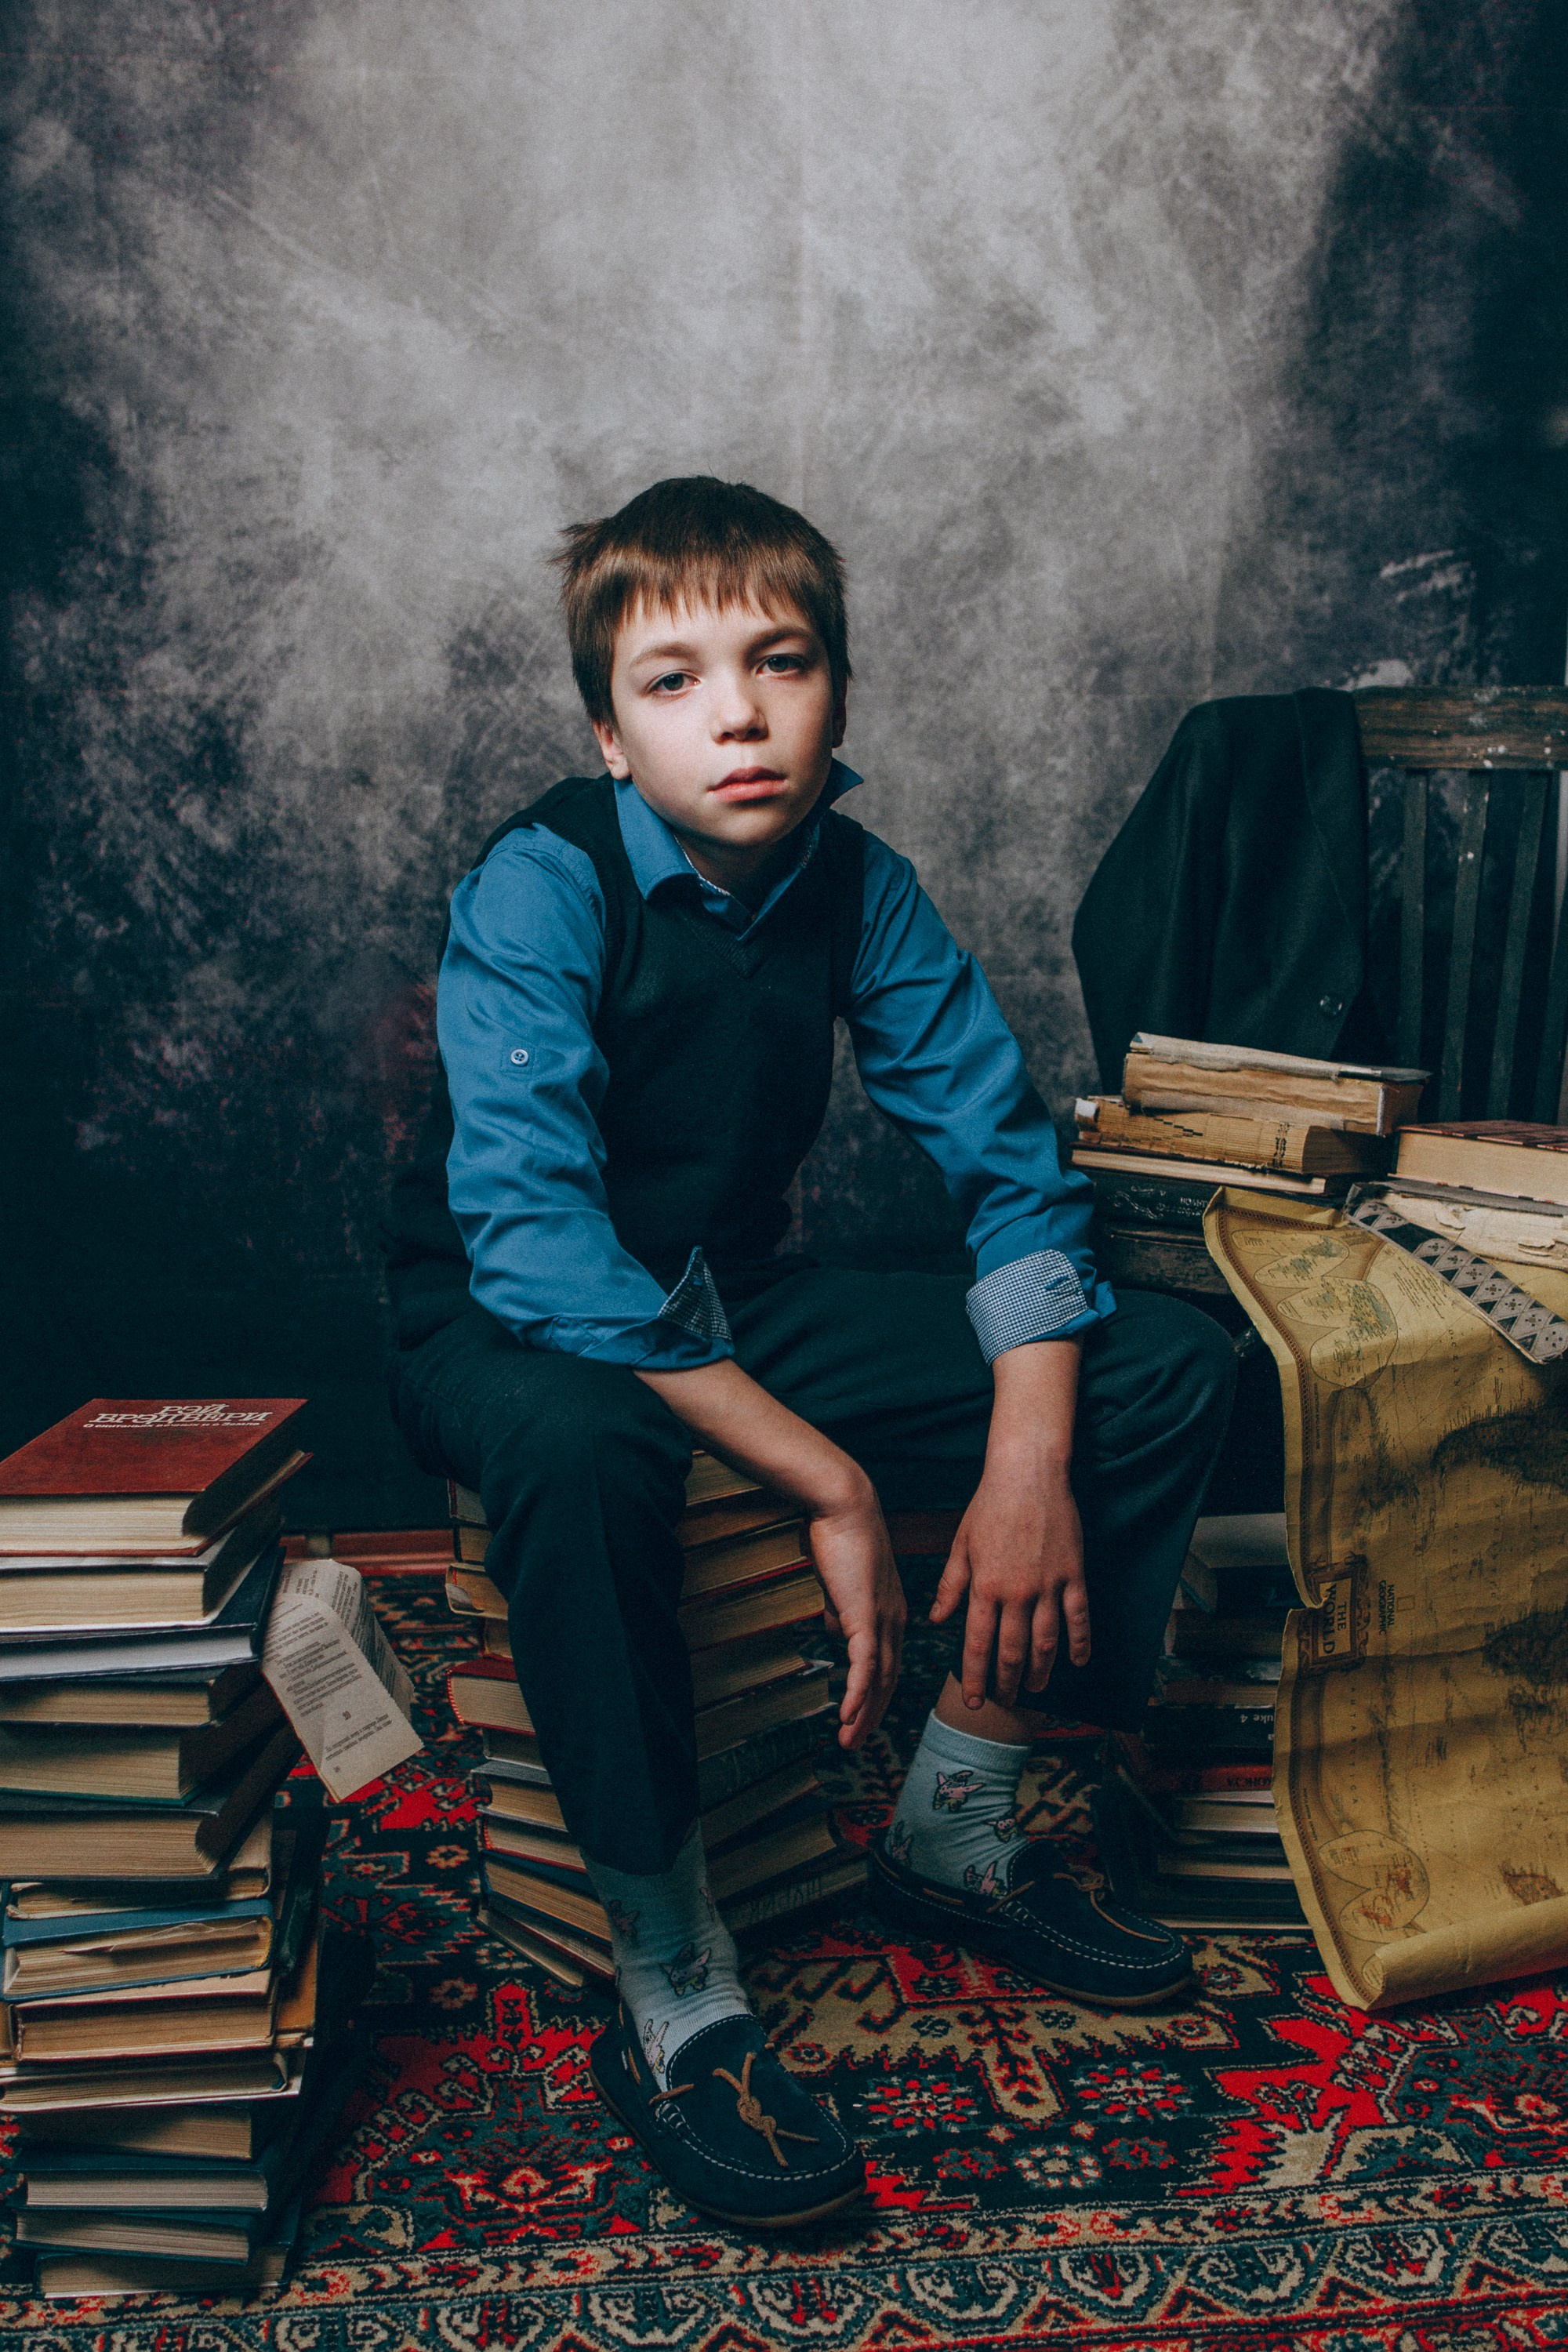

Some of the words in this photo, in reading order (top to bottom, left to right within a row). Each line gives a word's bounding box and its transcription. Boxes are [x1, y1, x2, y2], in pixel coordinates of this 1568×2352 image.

[154, 1404, 229, 1415] РЭЙ
[89, 1412, 273, 1425] БРЭДБЕРИ
[1323, 1584, 1336, 1654] WORLD
[1338, 1601, 1347, 1630] THE
[1240, 1714, 1248, 1723] 4
